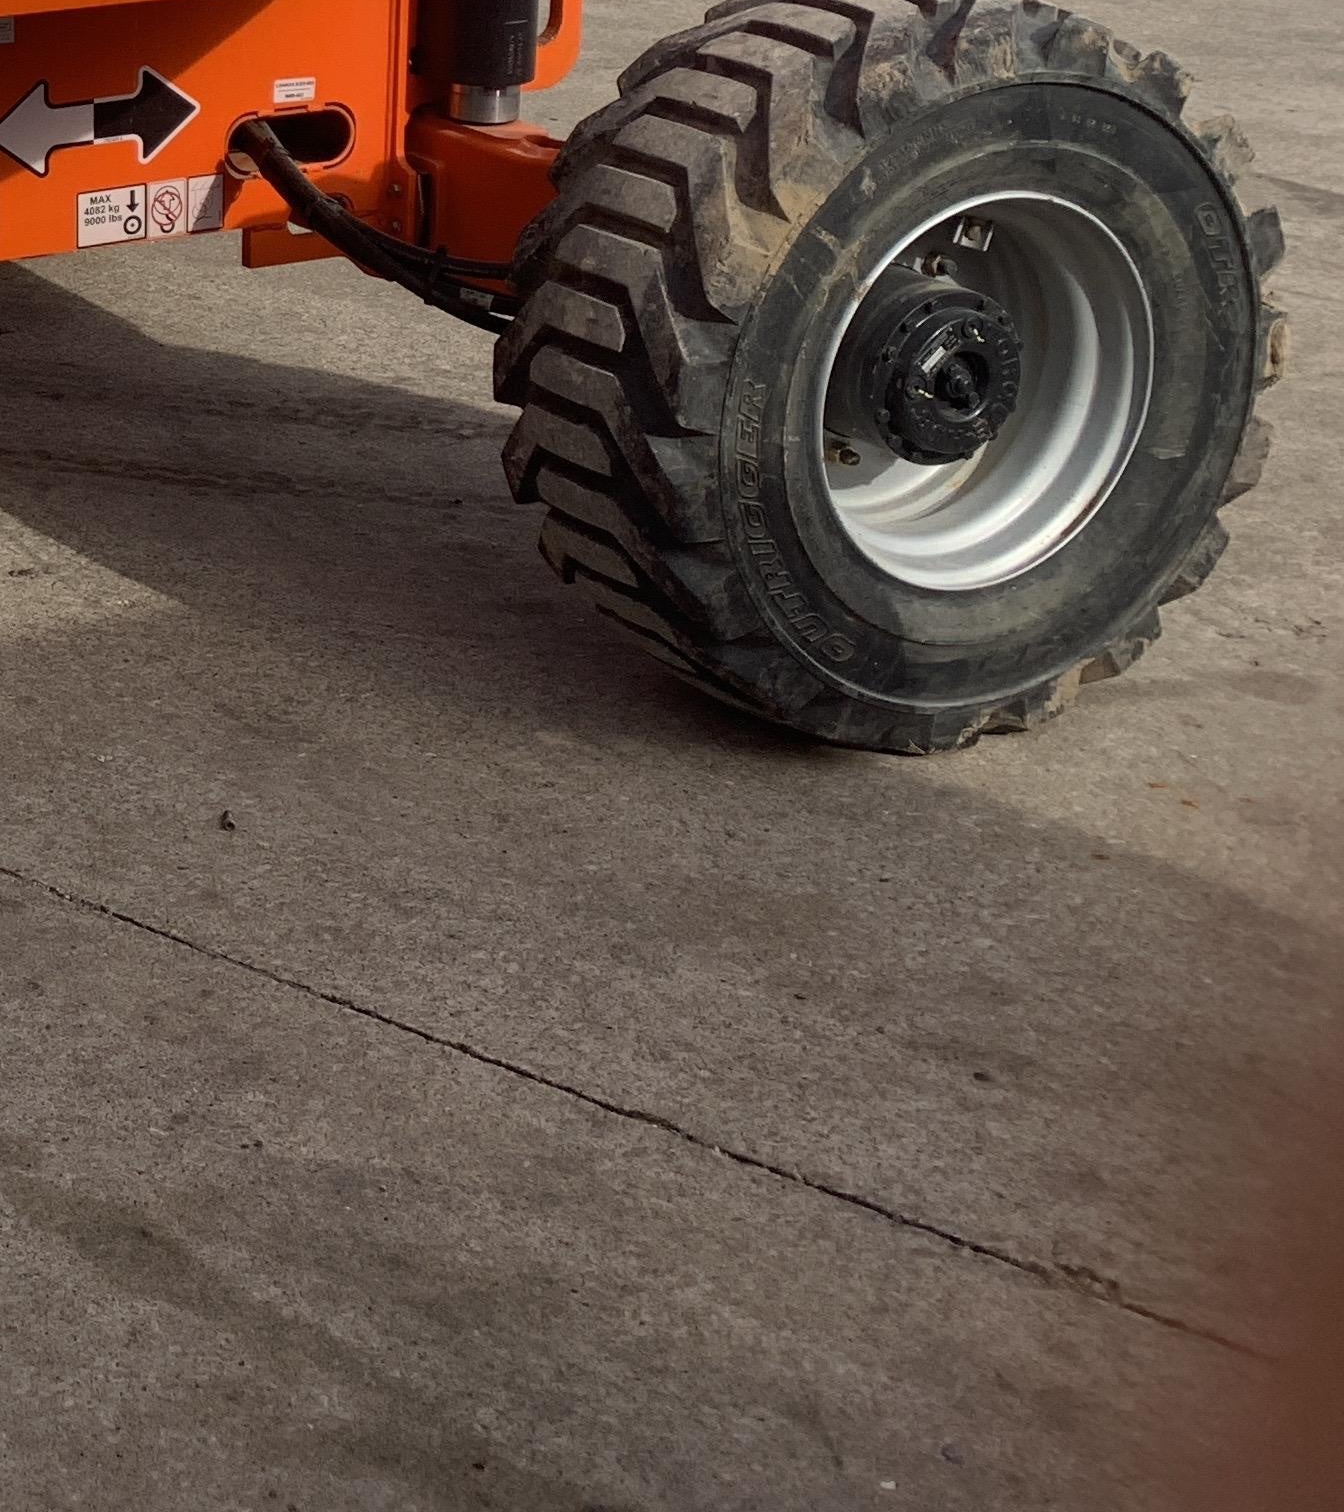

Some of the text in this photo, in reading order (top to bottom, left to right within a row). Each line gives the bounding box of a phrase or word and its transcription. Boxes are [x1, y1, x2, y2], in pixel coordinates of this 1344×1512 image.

[90, 194, 112, 205] MAX
[84, 204, 120, 216] 4082 kg
[84, 214, 123, 227] 9000 lbs
